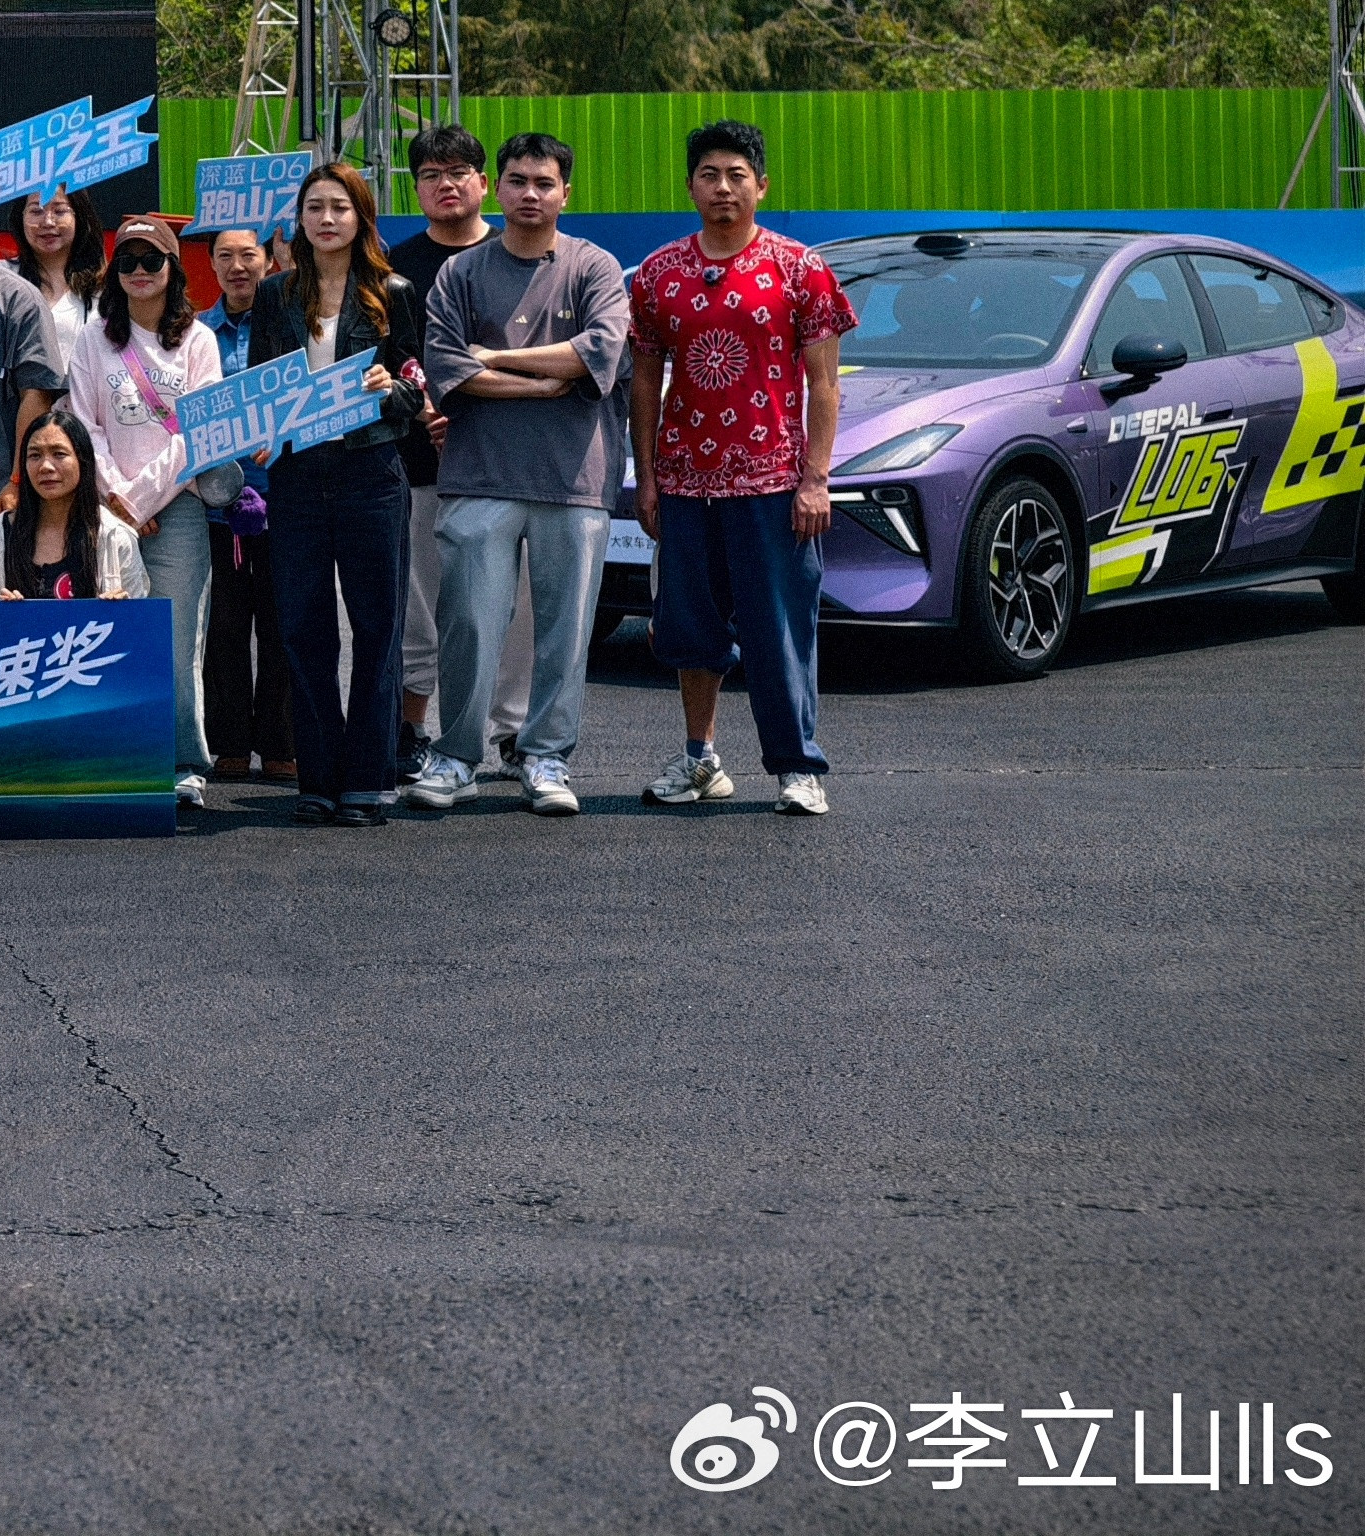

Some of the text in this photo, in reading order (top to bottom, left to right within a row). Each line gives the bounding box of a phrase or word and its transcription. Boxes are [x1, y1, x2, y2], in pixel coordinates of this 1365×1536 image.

[73, 146, 143, 185] 驾控创造营
[200, 157, 304, 189] 深蓝L06
[196, 183, 296, 230] 跑山之
[183, 360, 302, 427] 深蓝L06
[187, 366, 372, 470] 跑山之王
[299, 402, 374, 444] 驾控创造营
[1108, 401, 1202, 443] DEEPAL
[1110, 420, 1246, 533] L06
